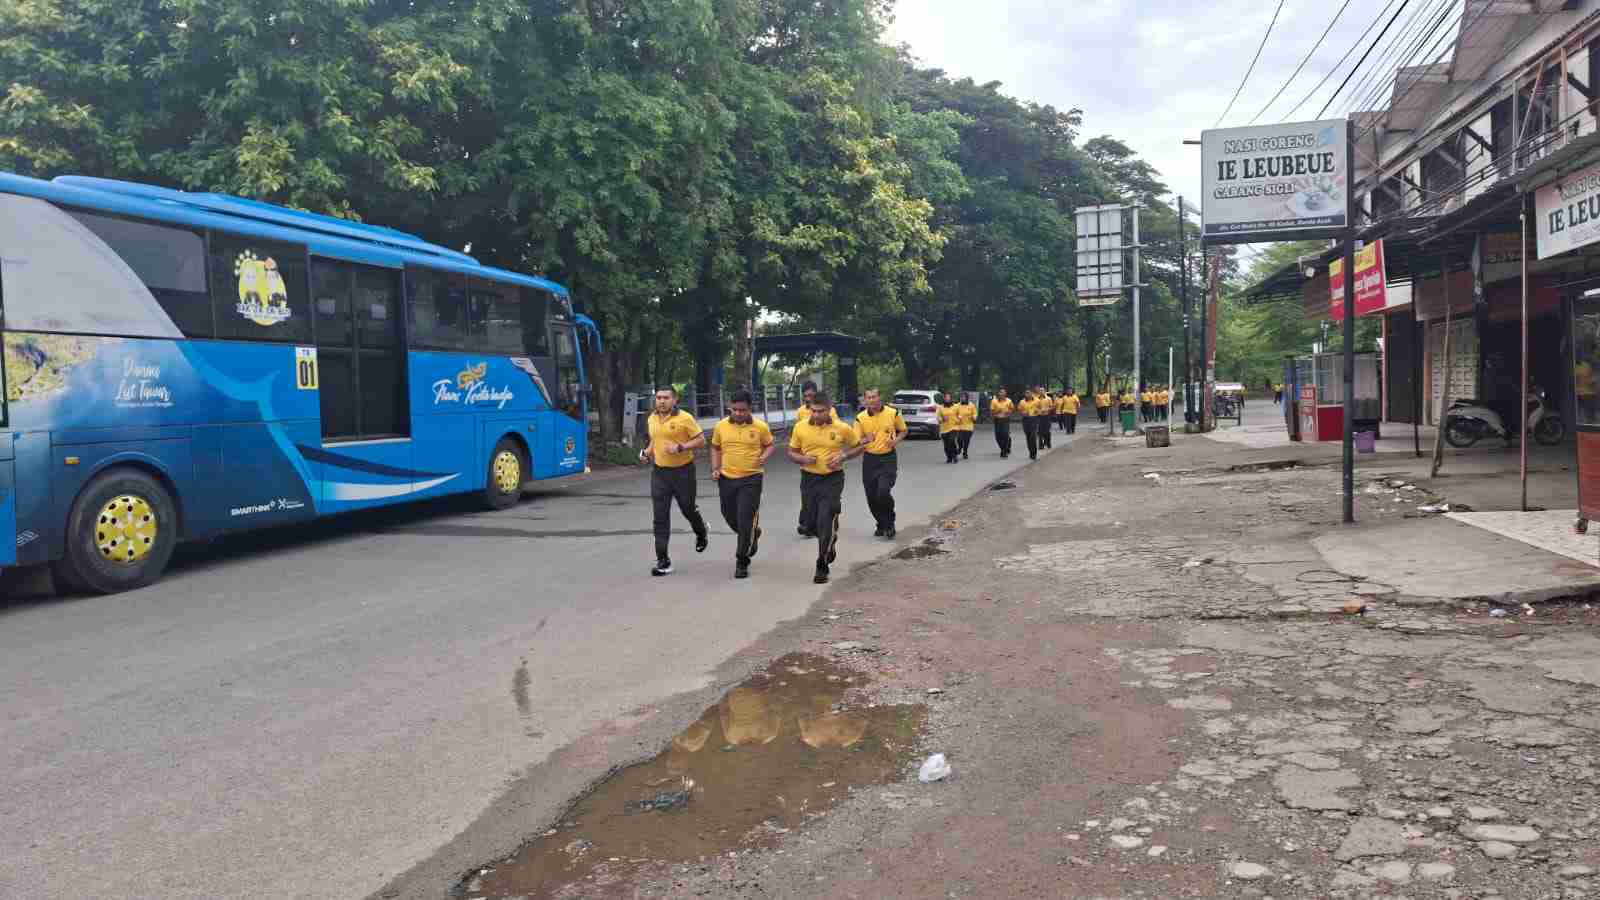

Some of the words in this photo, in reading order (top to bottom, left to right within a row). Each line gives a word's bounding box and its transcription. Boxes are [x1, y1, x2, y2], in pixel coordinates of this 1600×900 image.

[1224, 138, 1257, 154] NASI
[1260, 134, 1314, 151] GORENG
[1217, 160, 1237, 181] IE
[1243, 152, 1335, 179] LEUBEUE
[1214, 184, 1262, 200] CABANG
[1264, 183, 1295, 196] SIGLI
[1549, 208, 1564, 235] IE
[300, 360, 315, 387] 01
